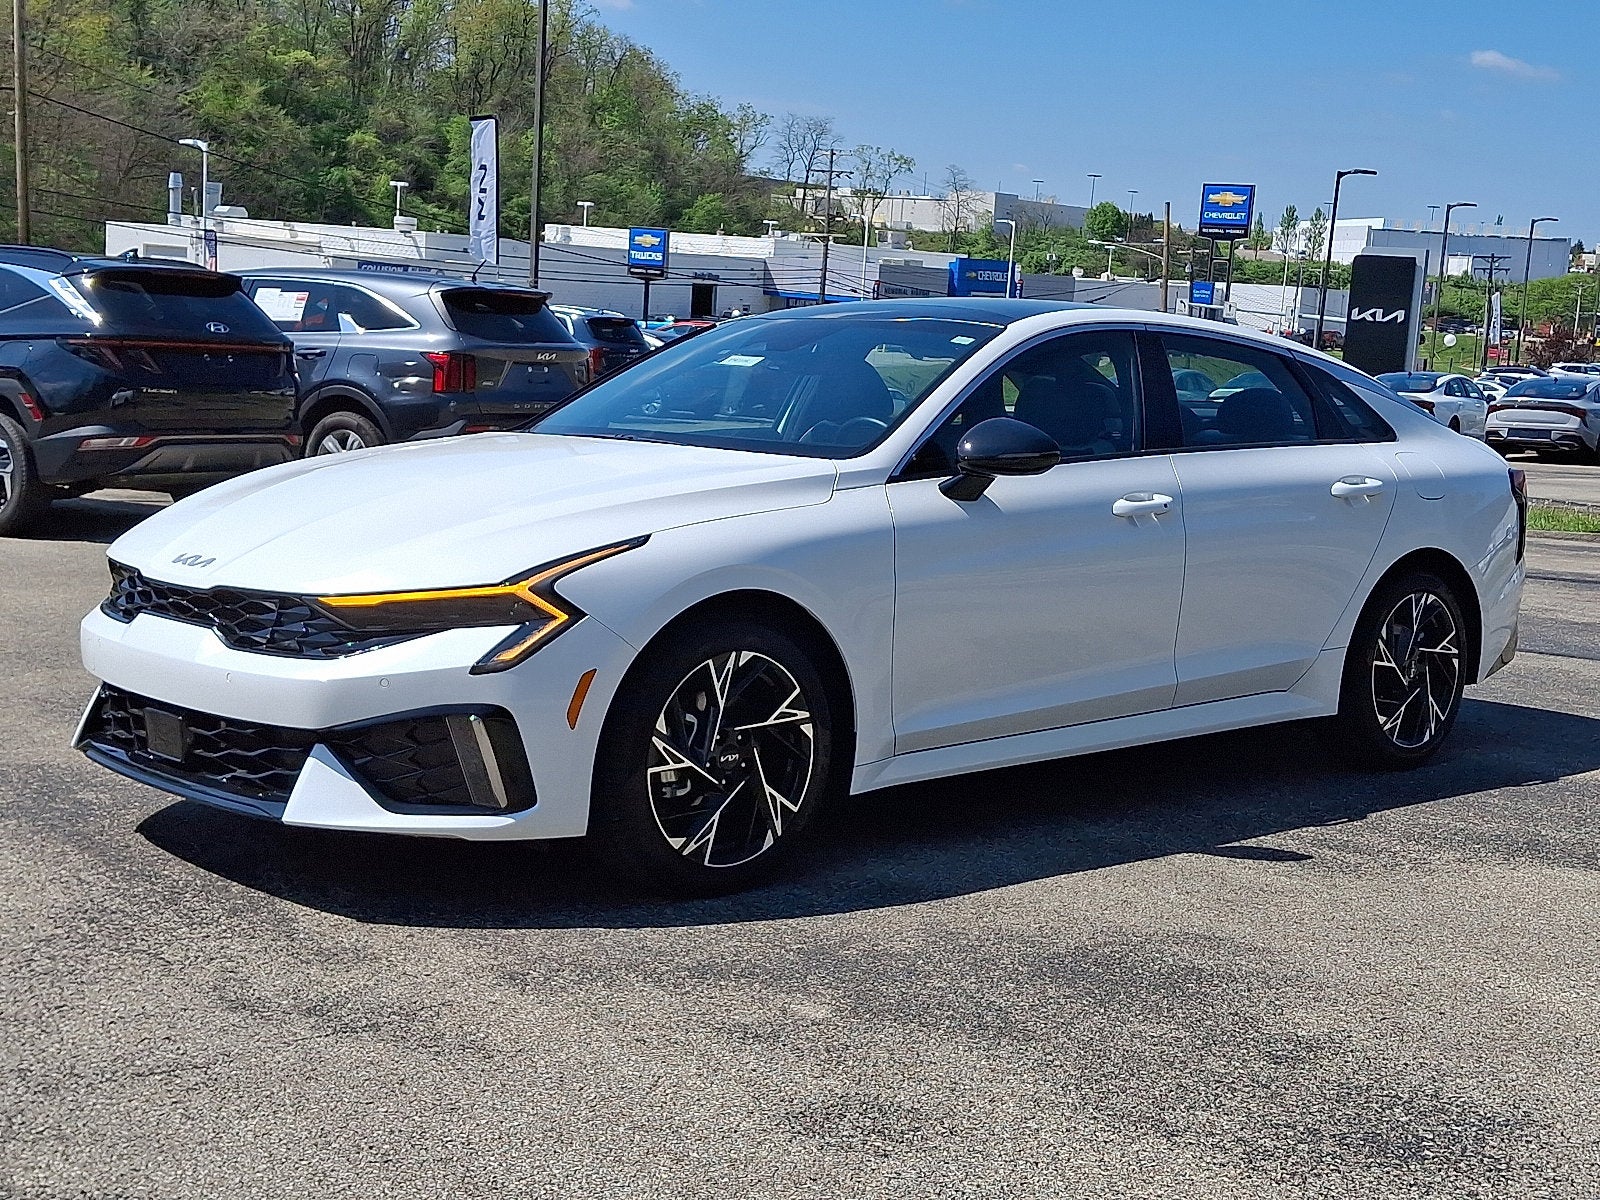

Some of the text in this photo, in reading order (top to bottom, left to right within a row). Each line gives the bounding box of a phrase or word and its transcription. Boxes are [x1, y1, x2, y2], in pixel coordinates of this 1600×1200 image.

[1203, 211, 1247, 220] CHEVROLET
[630, 250, 664, 261] TRUCKS
[977, 270, 1009, 282] CHEVROLE
[1351, 306, 1405, 324] KIA
[171, 552, 217, 569] KIA
